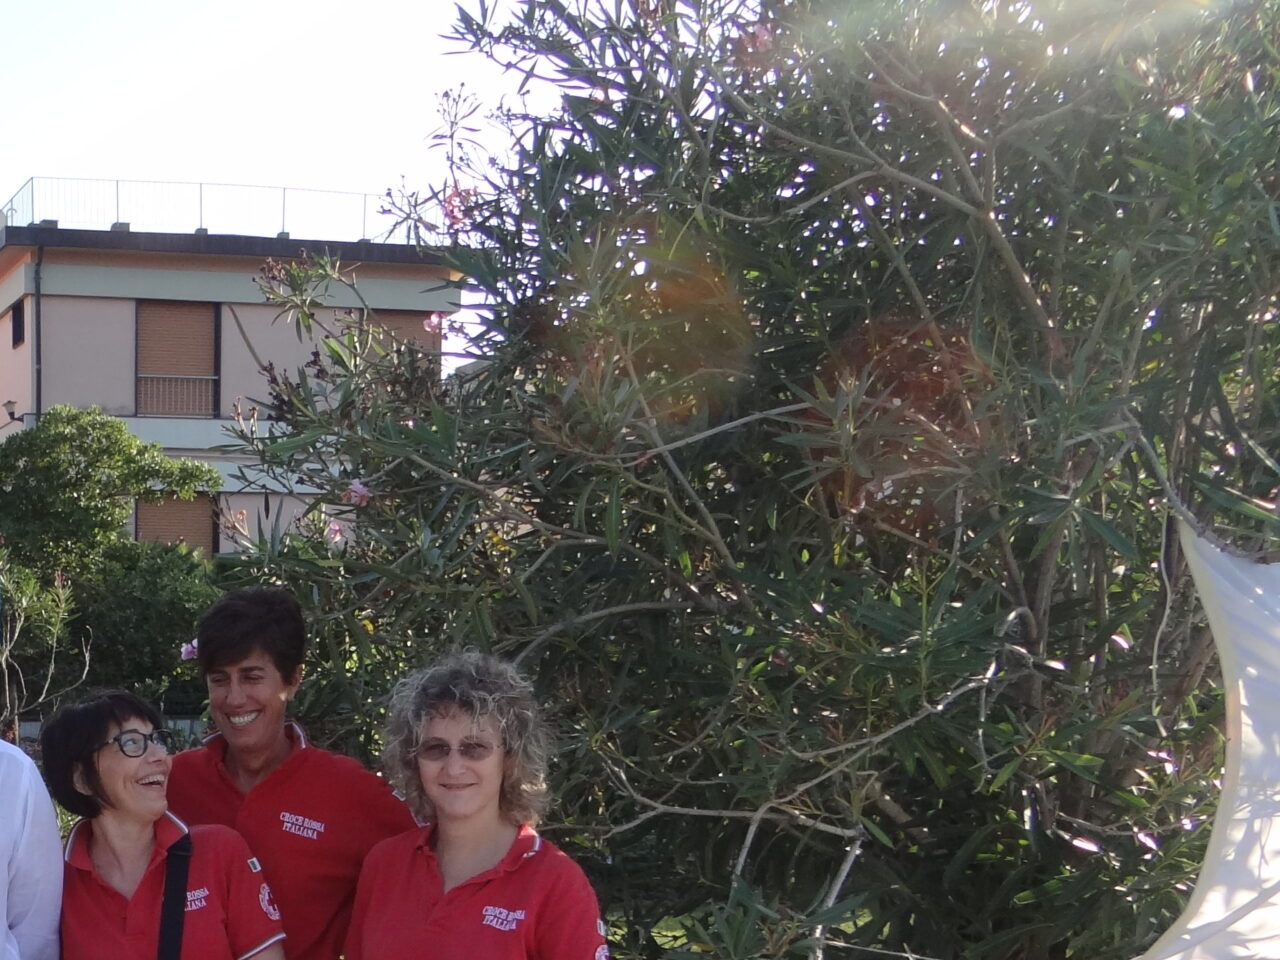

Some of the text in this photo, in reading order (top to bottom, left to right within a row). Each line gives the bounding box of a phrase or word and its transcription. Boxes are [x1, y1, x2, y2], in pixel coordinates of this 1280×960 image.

[280, 811, 325, 832] CROCE ROSSA
[282, 822, 317, 839] ITALIANA
[186, 887, 209, 901] ROSSA
